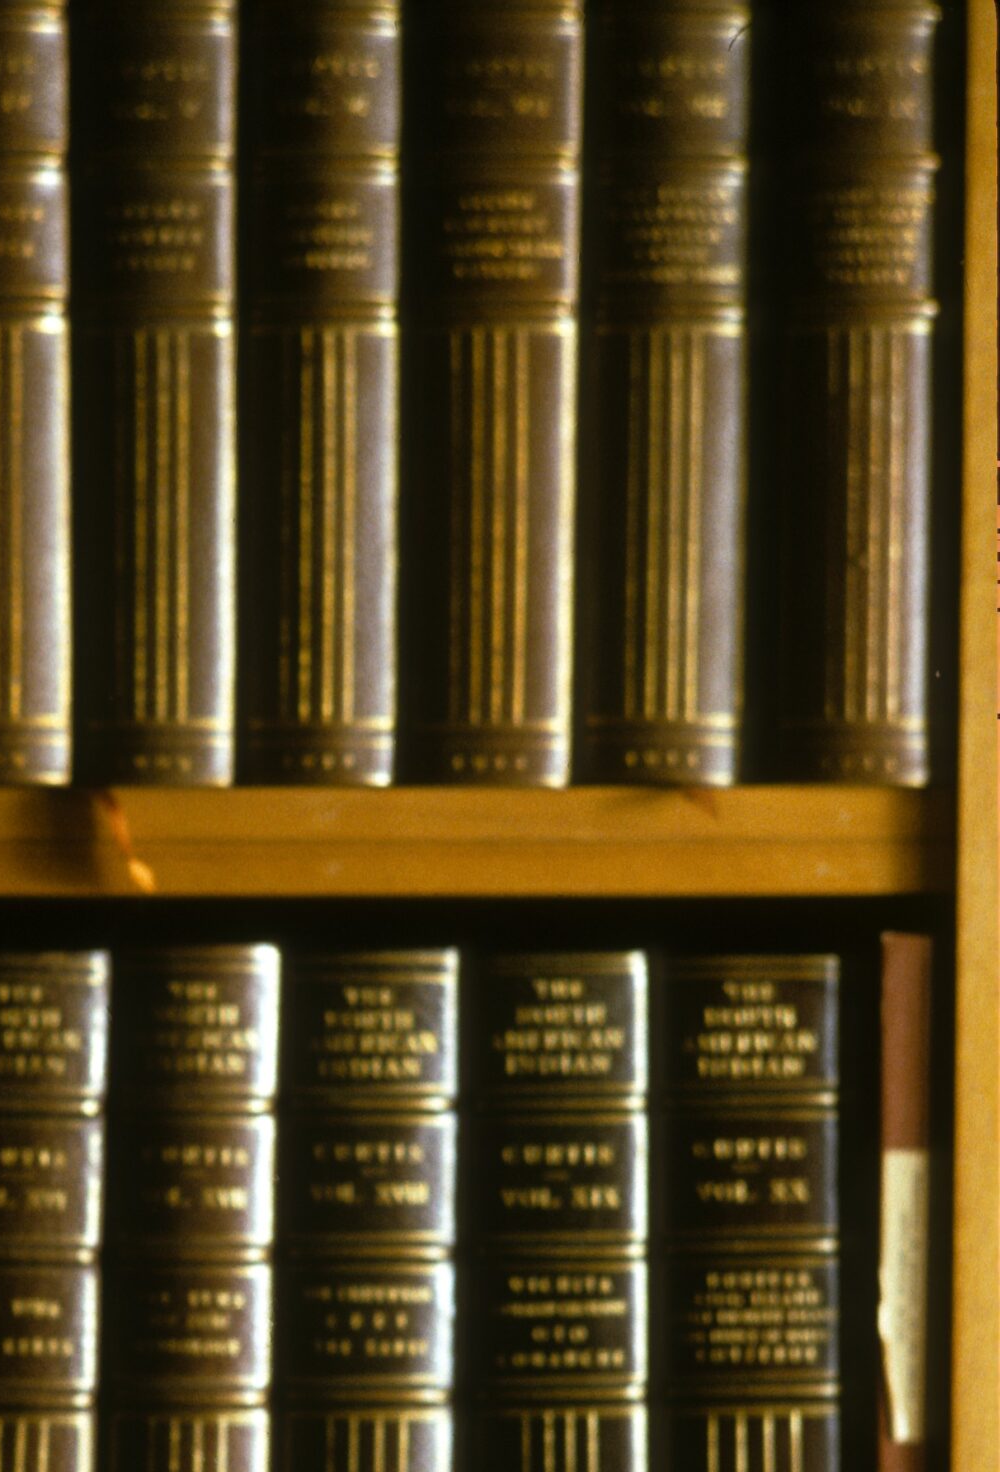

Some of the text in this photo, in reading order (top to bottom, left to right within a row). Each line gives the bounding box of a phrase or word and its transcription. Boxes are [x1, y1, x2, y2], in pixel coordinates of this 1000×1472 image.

[533, 979, 583, 999] THE
[721, 980, 774, 1000] THE
[505, 1054, 613, 1076] INDIAN
